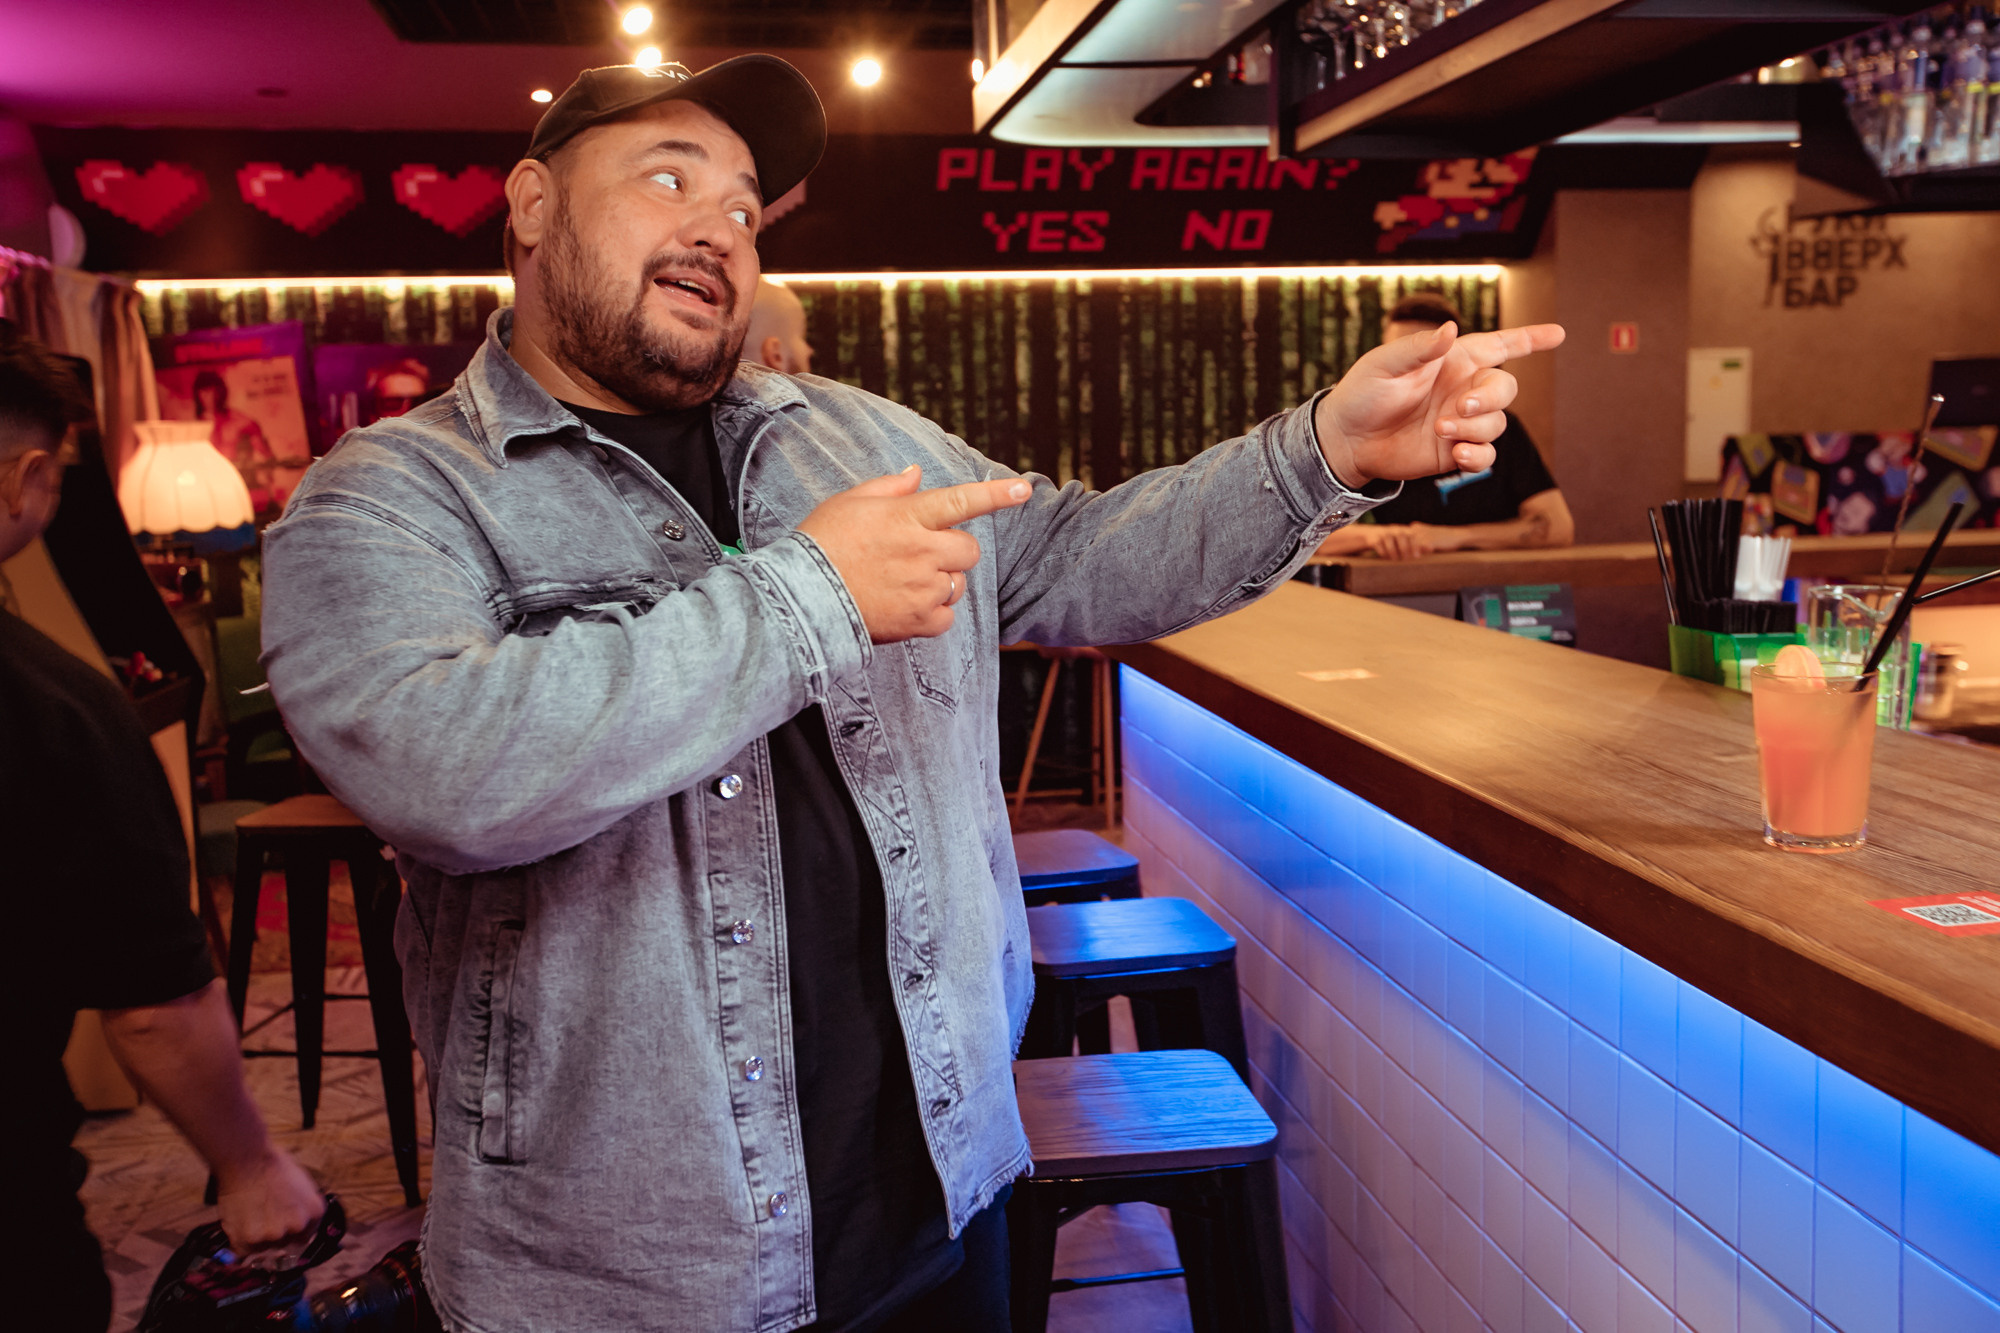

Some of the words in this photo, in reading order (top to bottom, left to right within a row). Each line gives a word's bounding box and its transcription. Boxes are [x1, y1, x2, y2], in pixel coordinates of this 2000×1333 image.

[937, 148, 1115, 191] PLAY
[1130, 148, 1360, 190] AGAIN?
[982, 211, 1110, 252] YES
[1181, 209, 1272, 250] NO
[1786, 237, 1907, 270] ВВЕРХ
[1784, 276, 1858, 308] БАР
